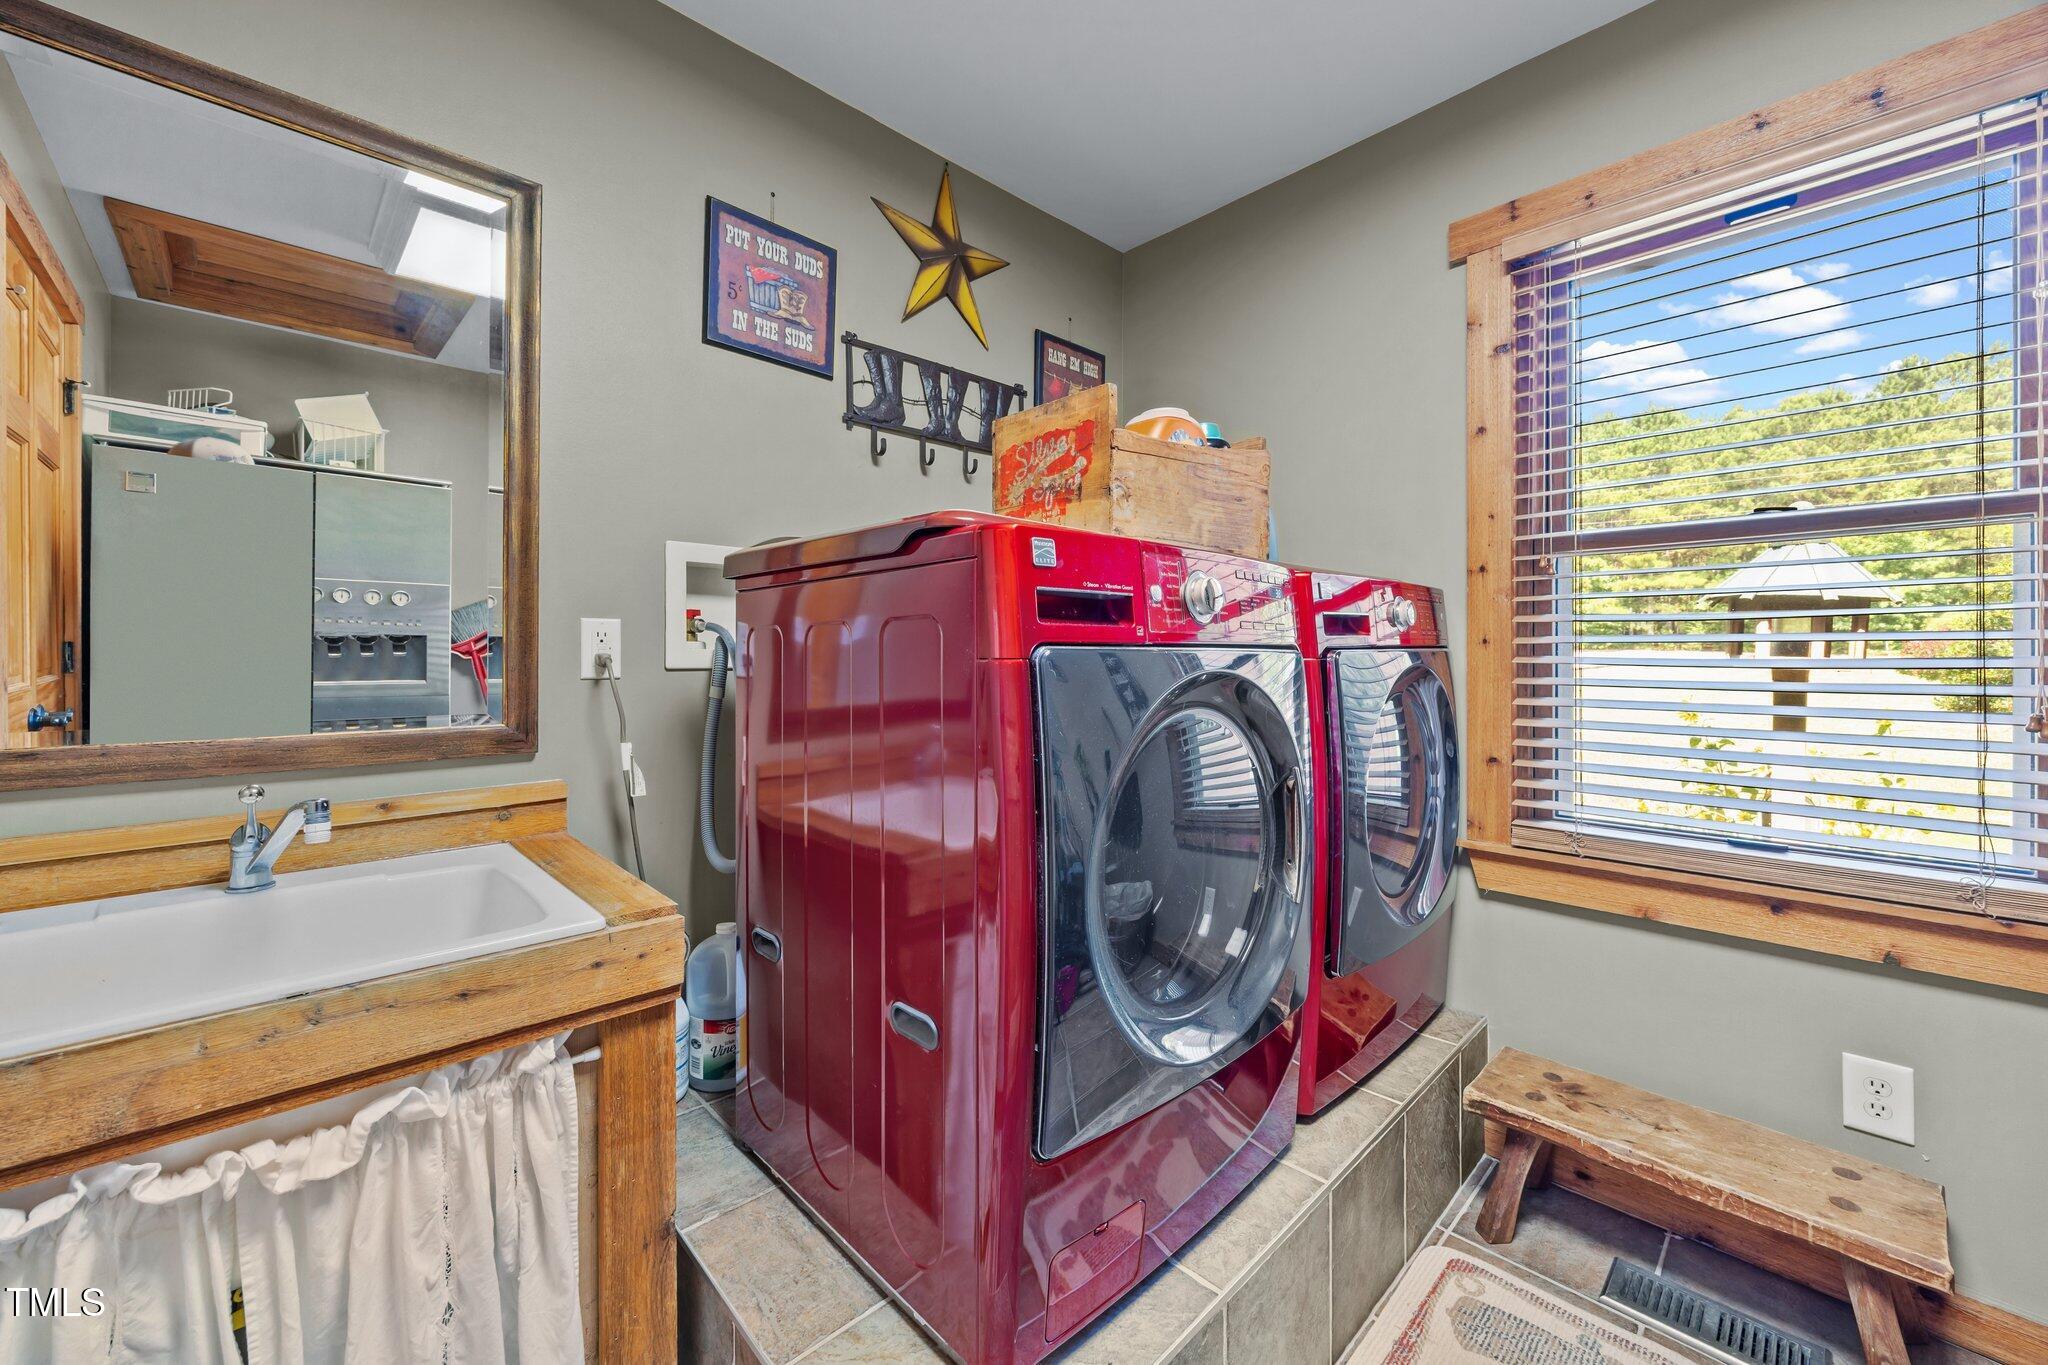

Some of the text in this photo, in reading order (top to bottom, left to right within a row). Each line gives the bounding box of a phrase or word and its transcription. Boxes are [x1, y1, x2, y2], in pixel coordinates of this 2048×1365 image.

[725, 224, 823, 279] PUT YOUR DUDS
[732, 309, 813, 353] IN THE SUDS
[1048, 348, 1099, 379] HANG EM HIGH
[1035, 557, 1055, 565] ELITE
[710, 1044, 736, 1059] Vine
